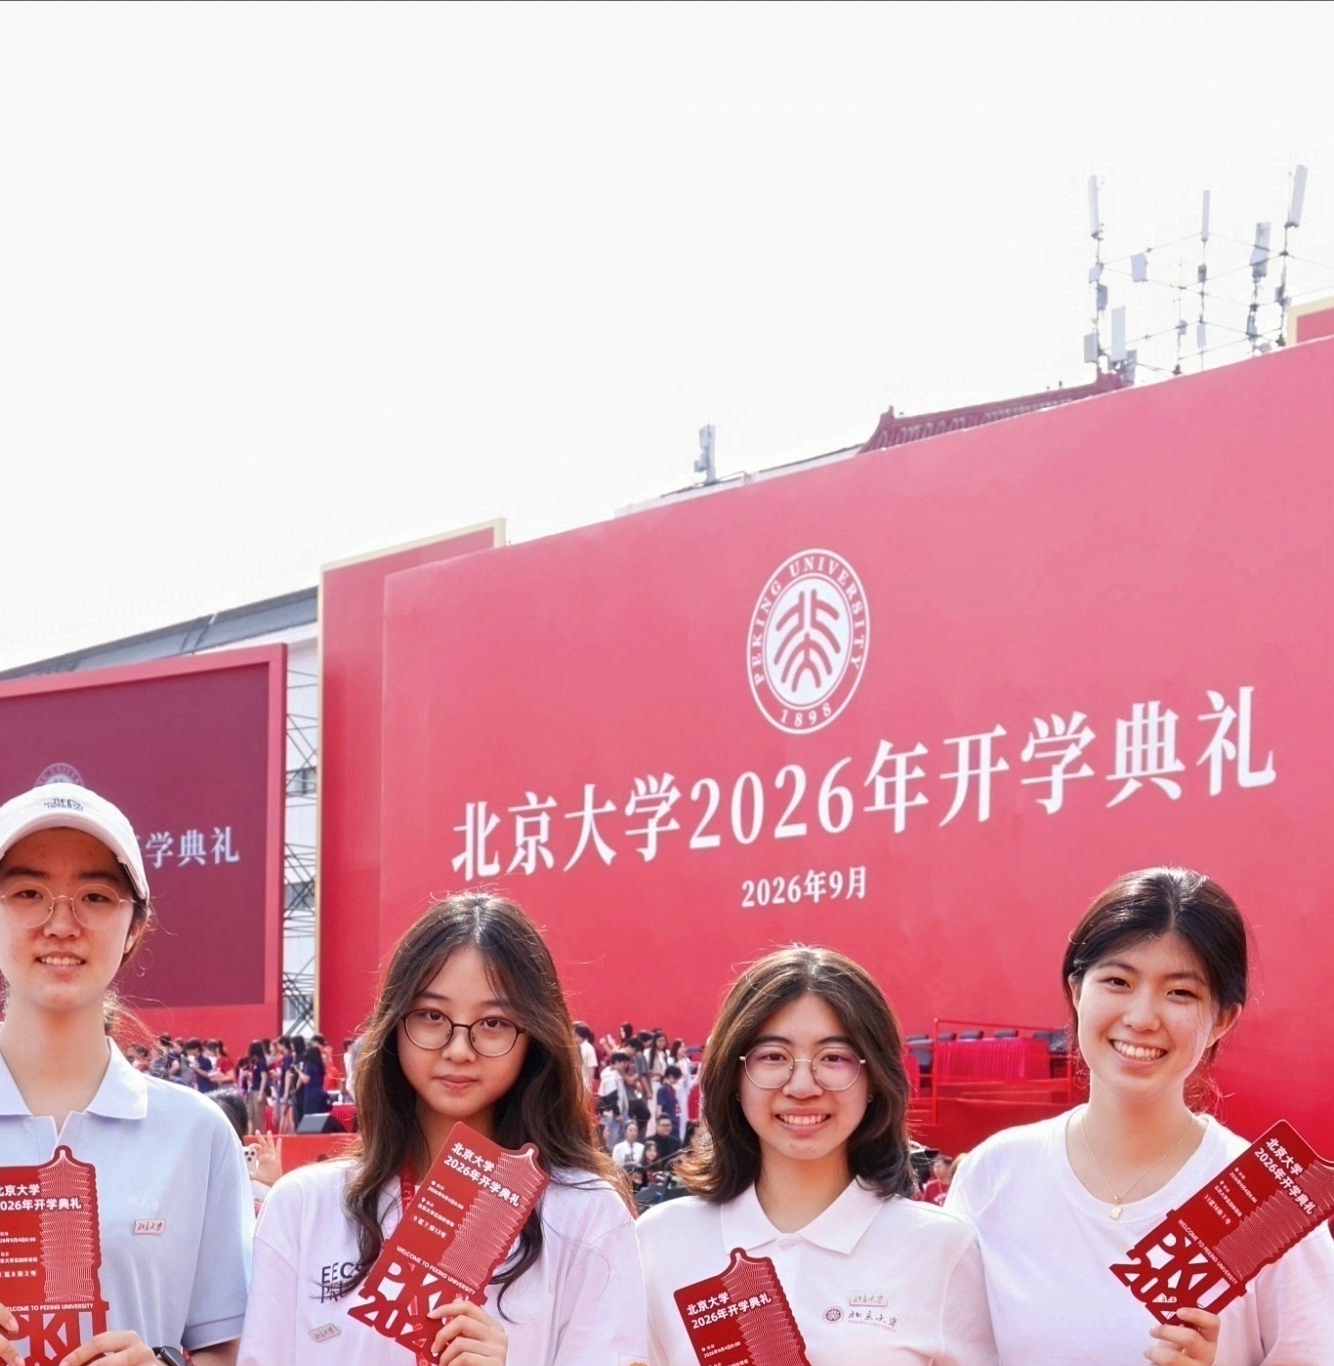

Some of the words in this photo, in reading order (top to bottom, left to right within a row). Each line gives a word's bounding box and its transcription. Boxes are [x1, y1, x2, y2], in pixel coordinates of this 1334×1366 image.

[752, 579, 783, 687] PEKING
[788, 555, 866, 670] UNIVERSITY
[779, 701, 833, 728] 1898
[450, 685, 1278, 883] 北京大学2026年开学典礼
[740, 864, 868, 910] 2026年9月
[450, 1141, 495, 1173] 北京大学
[1265, 1137, 1303, 1175] 北京大学
[443, 1154, 521, 1207] 2026年开学典礼
[1253, 1146, 1316, 1214] 2026年开学典礼
[395, 1245, 422, 1264] WELCOME
[428, 1264, 448, 1279] PEKING
[446, 1275, 475, 1295] UNIVERSITY
[1177, 1218, 1199, 1241] WELCOME
[1200, 1244, 1218, 1262] PEKING
[1213, 1258, 1238, 1284] UNIVERSITY
[39, 1303, 61, 1311] PEKING
[60, 1302, 93, 1310] UNIVERSITY
[686, 1291, 729, 1316] 北京大学
[690, 1292, 772, 1329] 2026年开学典礼
[847, 1310, 898, 1328] 北京大学
